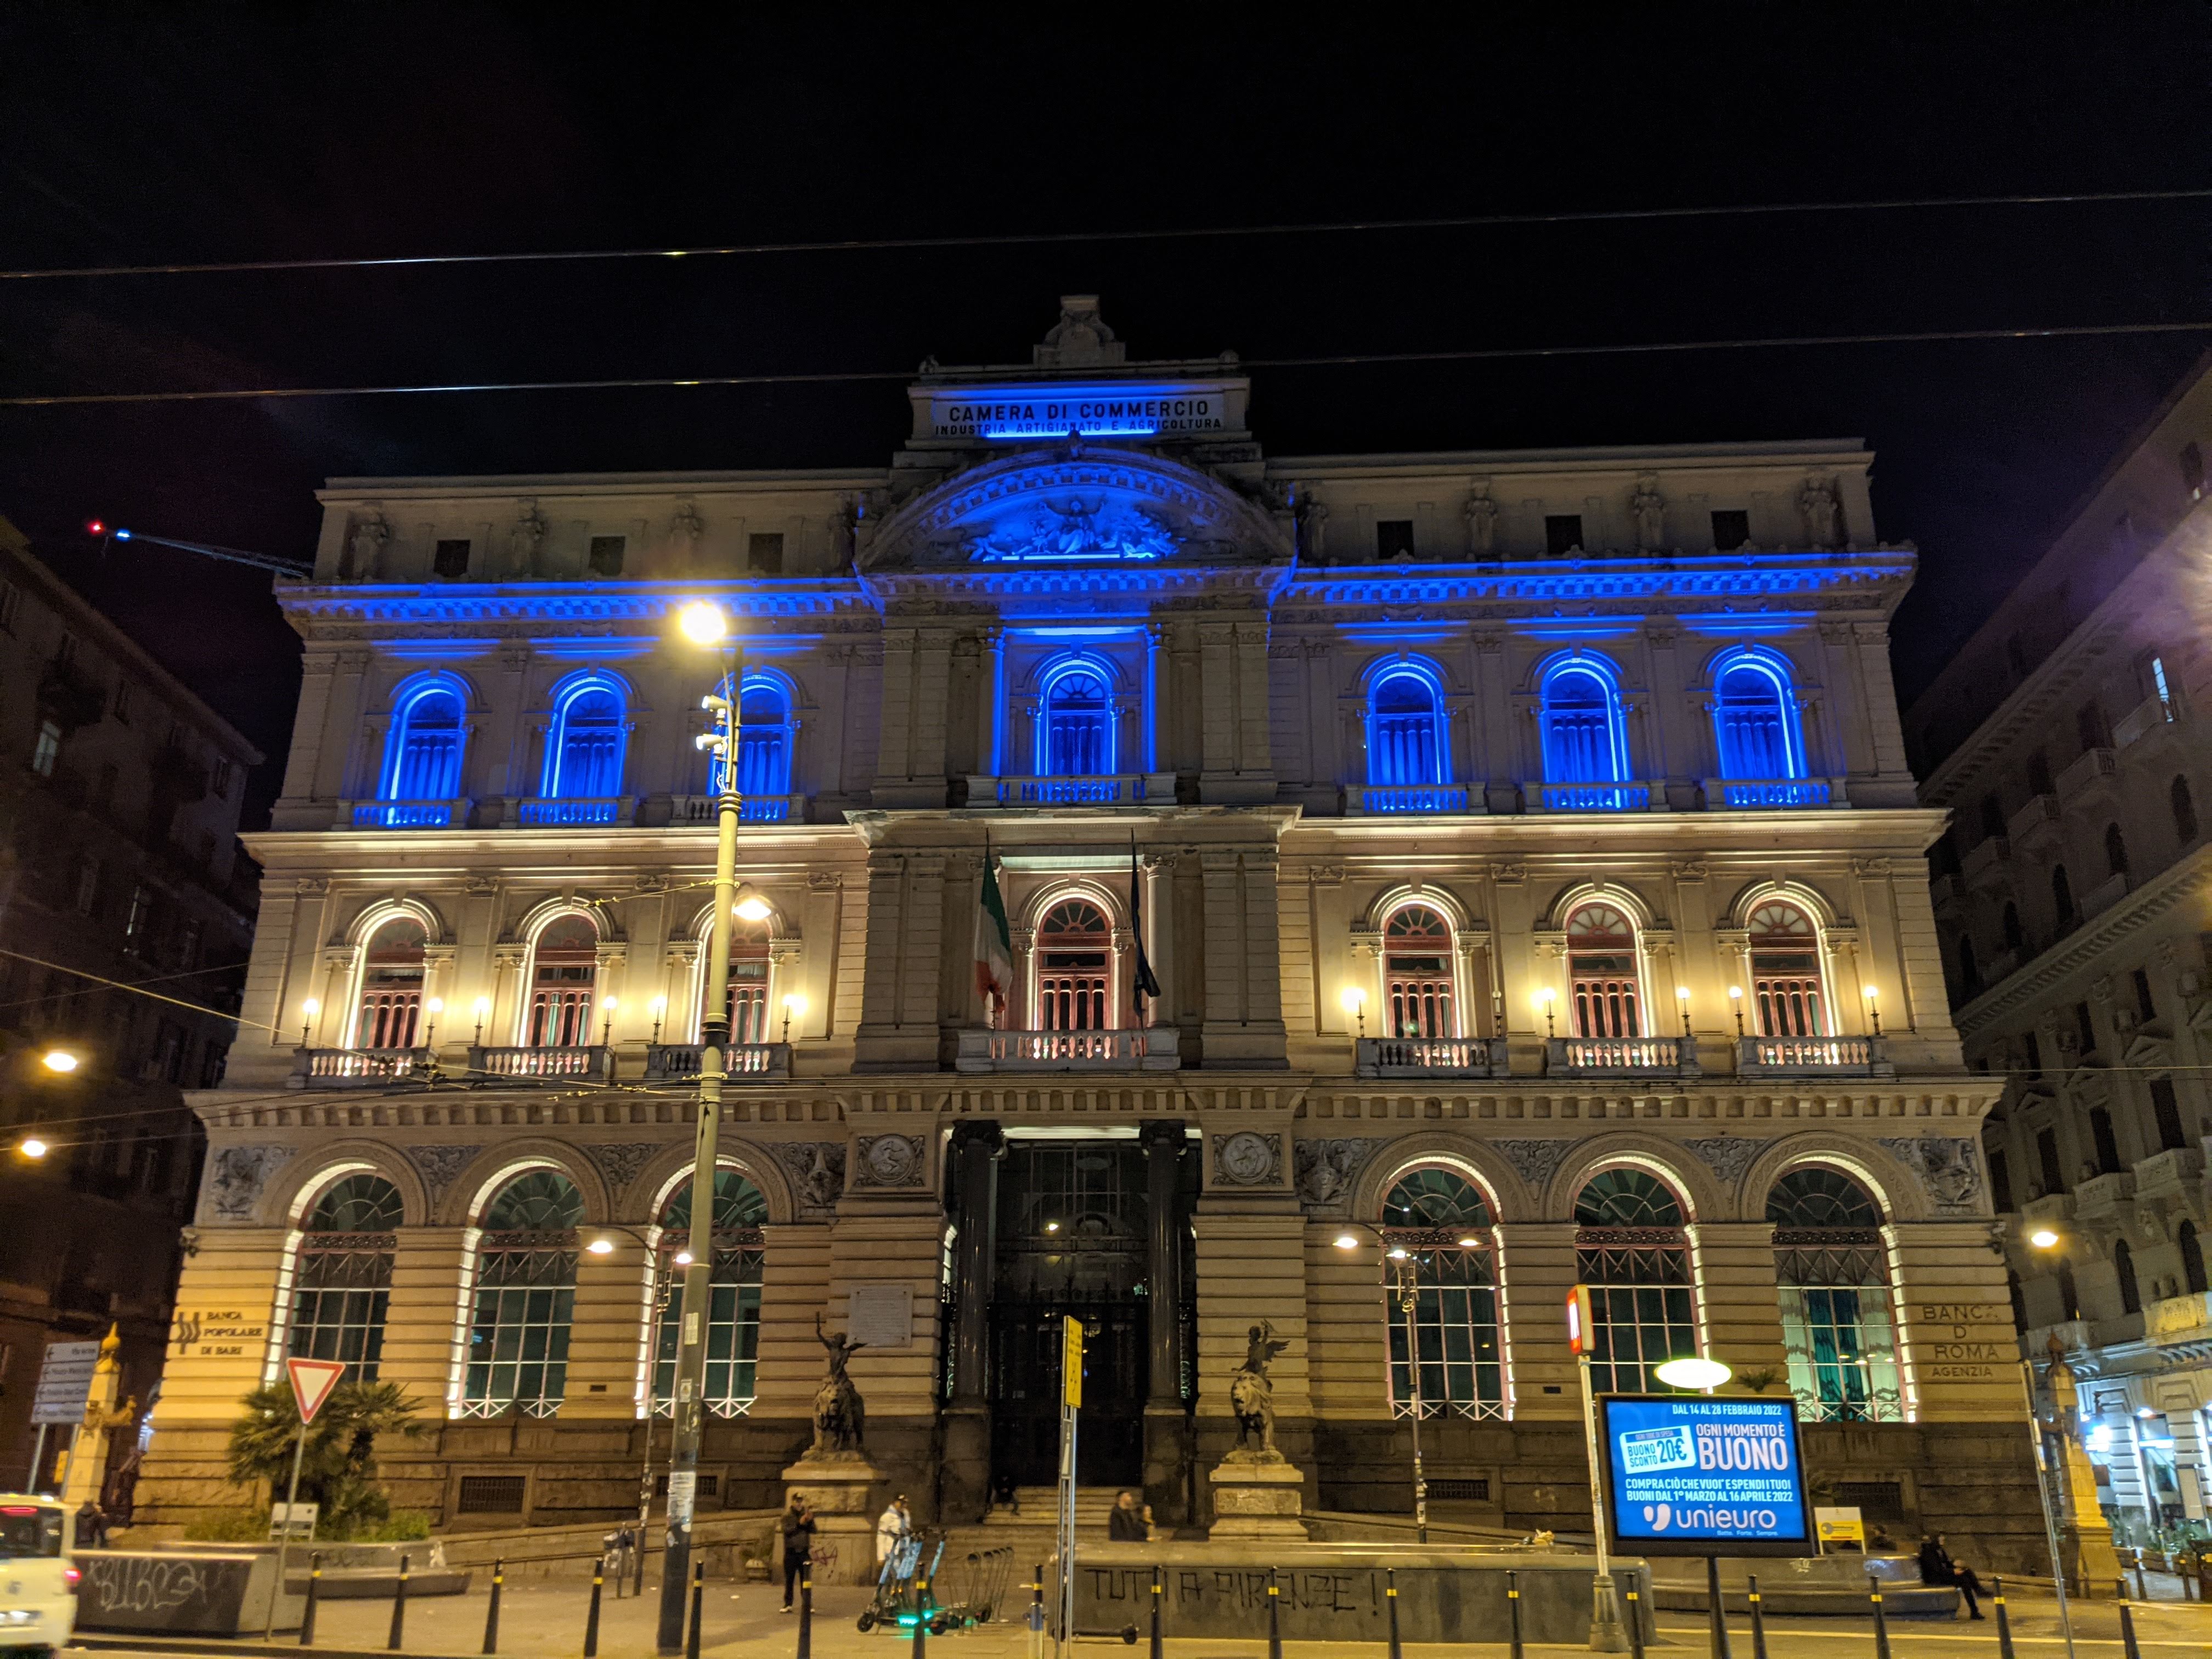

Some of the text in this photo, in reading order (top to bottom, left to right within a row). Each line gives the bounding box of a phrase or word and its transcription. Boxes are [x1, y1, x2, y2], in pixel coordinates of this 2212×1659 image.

[949, 400, 1208, 422] CAMERA DI COMMERCIO
[935, 418, 1221, 436] INDUSTRIA ARTIGIANATO E AGRICOLTURA
[206, 1311, 242, 1320] BANCA
[203, 1328, 263, 1336] POPOLARE
[201, 1346, 242, 1355] DI BARI
[1934, 1344, 2000, 1360] ROMA
[1931, 1366, 1994, 1377] AGENZIA
[1672, 1404, 1782, 1415] DAL 14 AL 28 FEBBRAIO 2022
[1696, 1421, 1786, 1437] OGNI MOMENTO È
[1627, 1443, 1656, 1457] BUONO
[1656, 1437, 1688, 1463] 20€
[1697, 1437, 1788, 1471] BUONO
[1629, 1454, 1658, 1468] SCONTO
[1625, 1478, 1664, 1489] COMPRA
[1664, 1476, 1681, 1489] CIÒ
[1681, 1479, 1700, 1489] CHE
[1725, 1479, 1731, 1490] E
[1731, 1479, 1765, 1490] SPENDI
[1769, 1479, 1792, 1490] TUOI
[1626, 1491, 1655, 1501] BUONI
[1655, 1491, 1673, 1502] DAL
[1684, 1491, 1717, 1502] MARZO
[1717, 1491, 1729, 1502] AL
[1729, 1491, 1740, 1502] 16
[1740, 1491, 1773, 1502] APRILE
[1772, 1491, 1793, 1502] 2022
[1675, 1504, 1776, 1529] unieuro
[1084, 1569, 1168, 1602] TUTI
